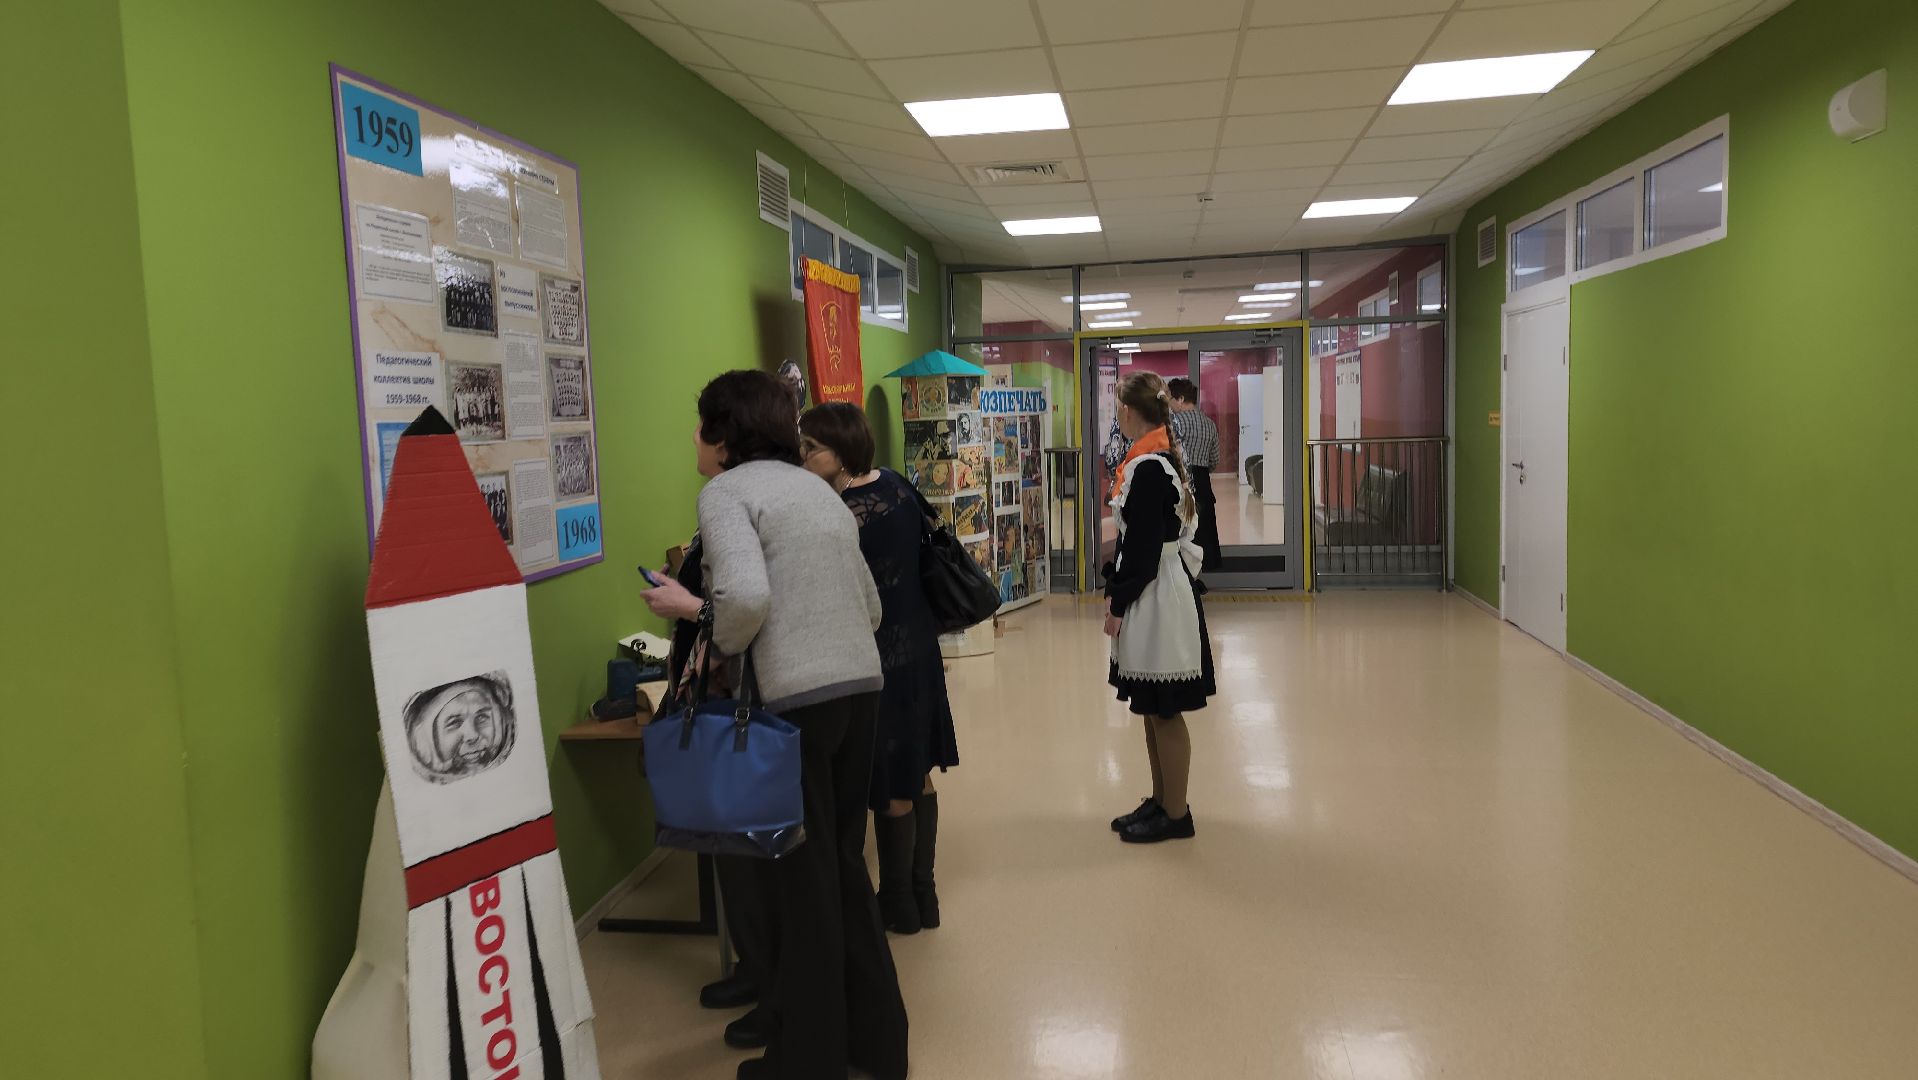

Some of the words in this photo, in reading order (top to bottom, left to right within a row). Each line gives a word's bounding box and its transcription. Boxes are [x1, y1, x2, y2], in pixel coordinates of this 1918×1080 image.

[353, 104, 413, 158] 1959
[376, 353, 432, 367] Педагогический
[373, 375, 411, 385] коллектив
[412, 376, 435, 385] школы
[386, 393, 421, 404] 1959-1968
[561, 515, 596, 550] 1968
[469, 875, 521, 1080] ВОСТО
